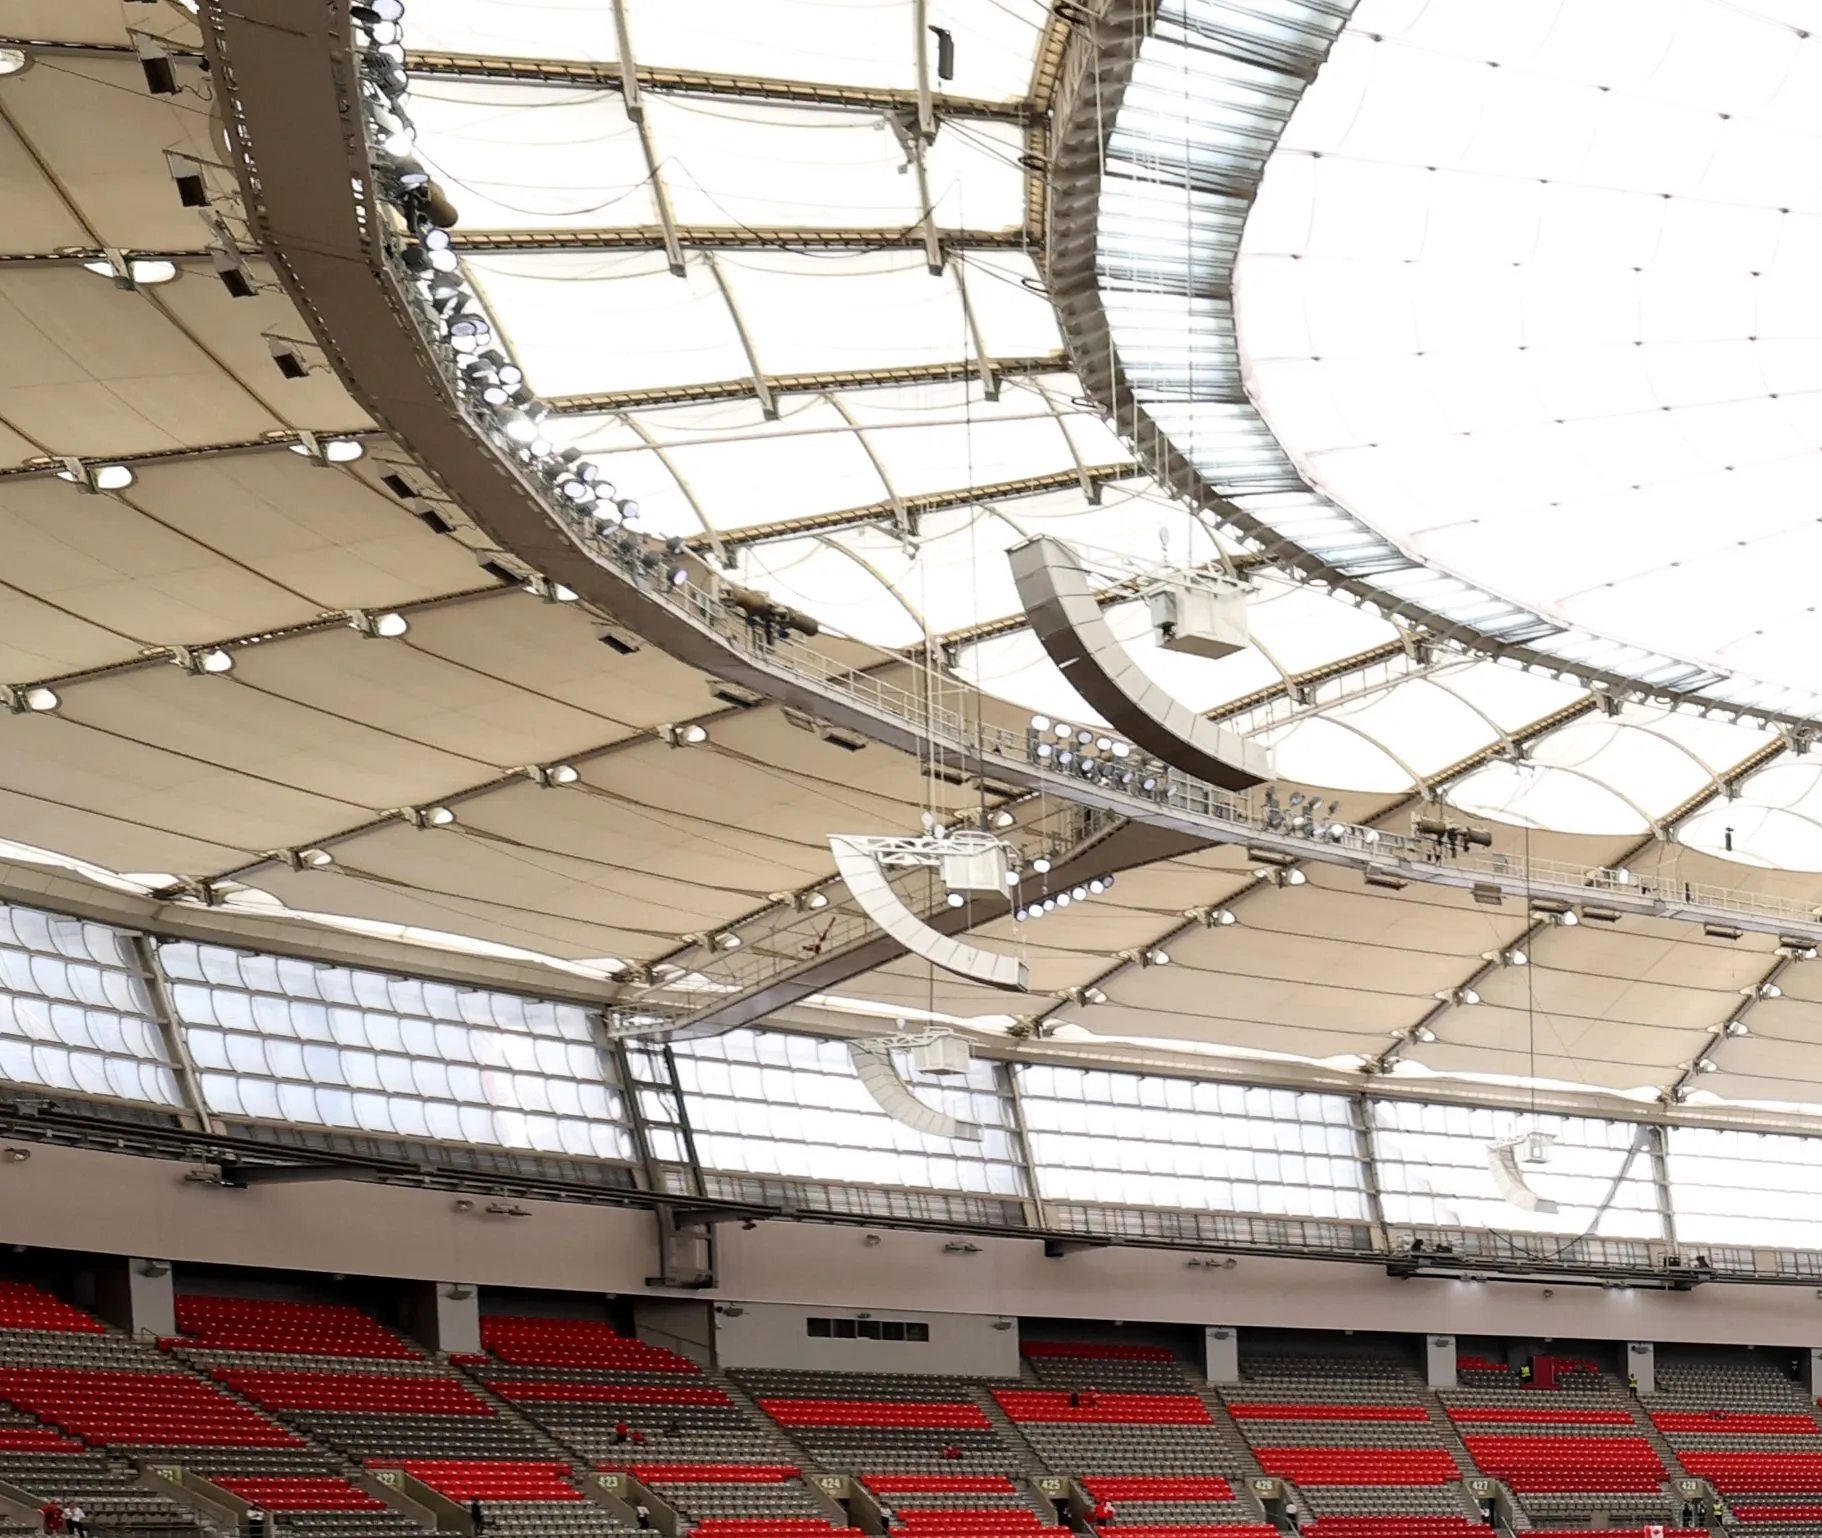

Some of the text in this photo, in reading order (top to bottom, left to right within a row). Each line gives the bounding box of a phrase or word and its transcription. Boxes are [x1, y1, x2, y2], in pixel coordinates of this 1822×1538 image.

[821, 1478, 841, 1489] 424
[1041, 1479, 1060, 1490] 425
[1472, 1480, 1489, 1490] 427
